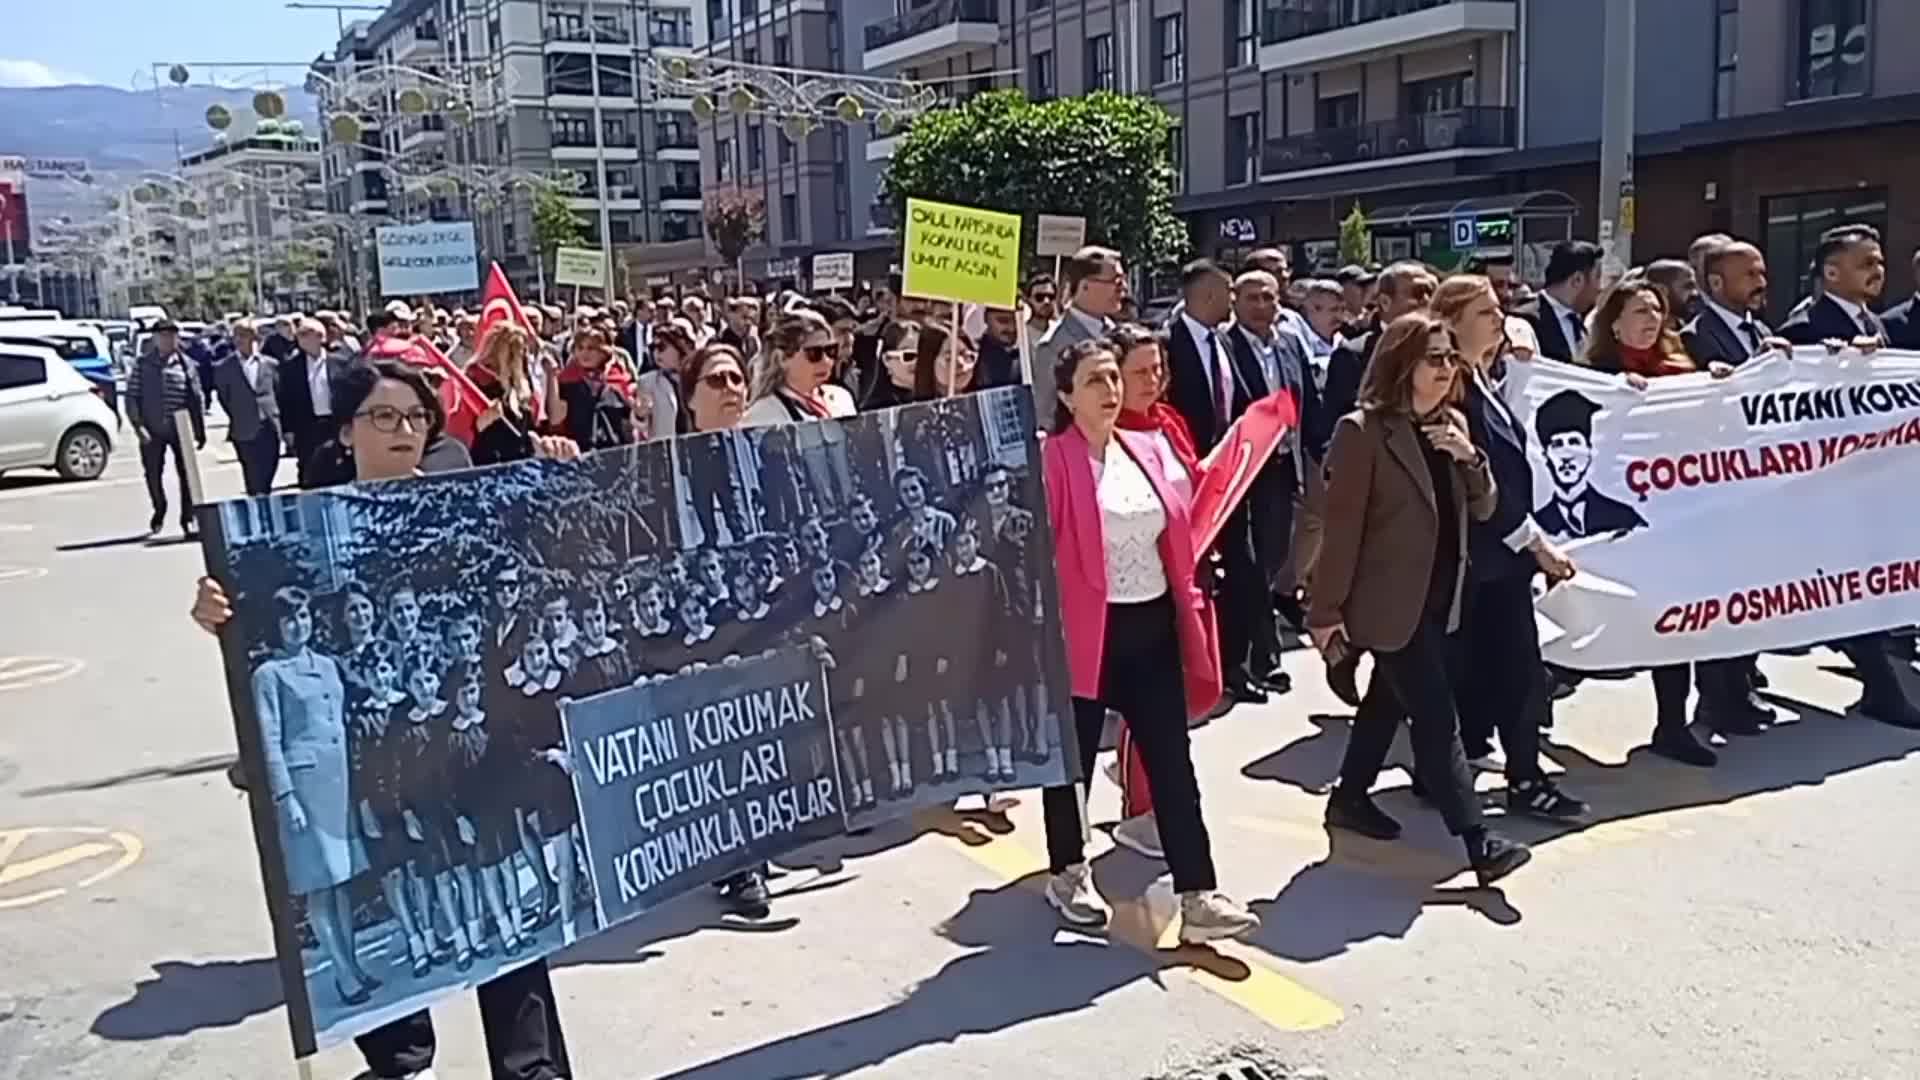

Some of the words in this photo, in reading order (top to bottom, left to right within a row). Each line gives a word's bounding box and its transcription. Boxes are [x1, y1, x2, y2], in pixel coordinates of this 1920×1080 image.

[911, 251, 948, 269] UMUT
[1458, 223, 1469, 241] D
[1741, 388, 1845, 425] VATANI
[1626, 441, 1813, 502] ÇOCUKLARI
[1654, 598, 1720, 633] CHP
[1726, 568, 1862, 625] OSMANİYE
[1866, 560, 1920, 596] GEN
[584, 717, 679, 785] VATANI
[685, 681, 814, 752] KORUMAK
[635, 740, 788, 832] ÇOCUKLARI
[614, 807, 745, 902] KORUMAKLA
[746, 777, 836, 841] BAŞLAR
